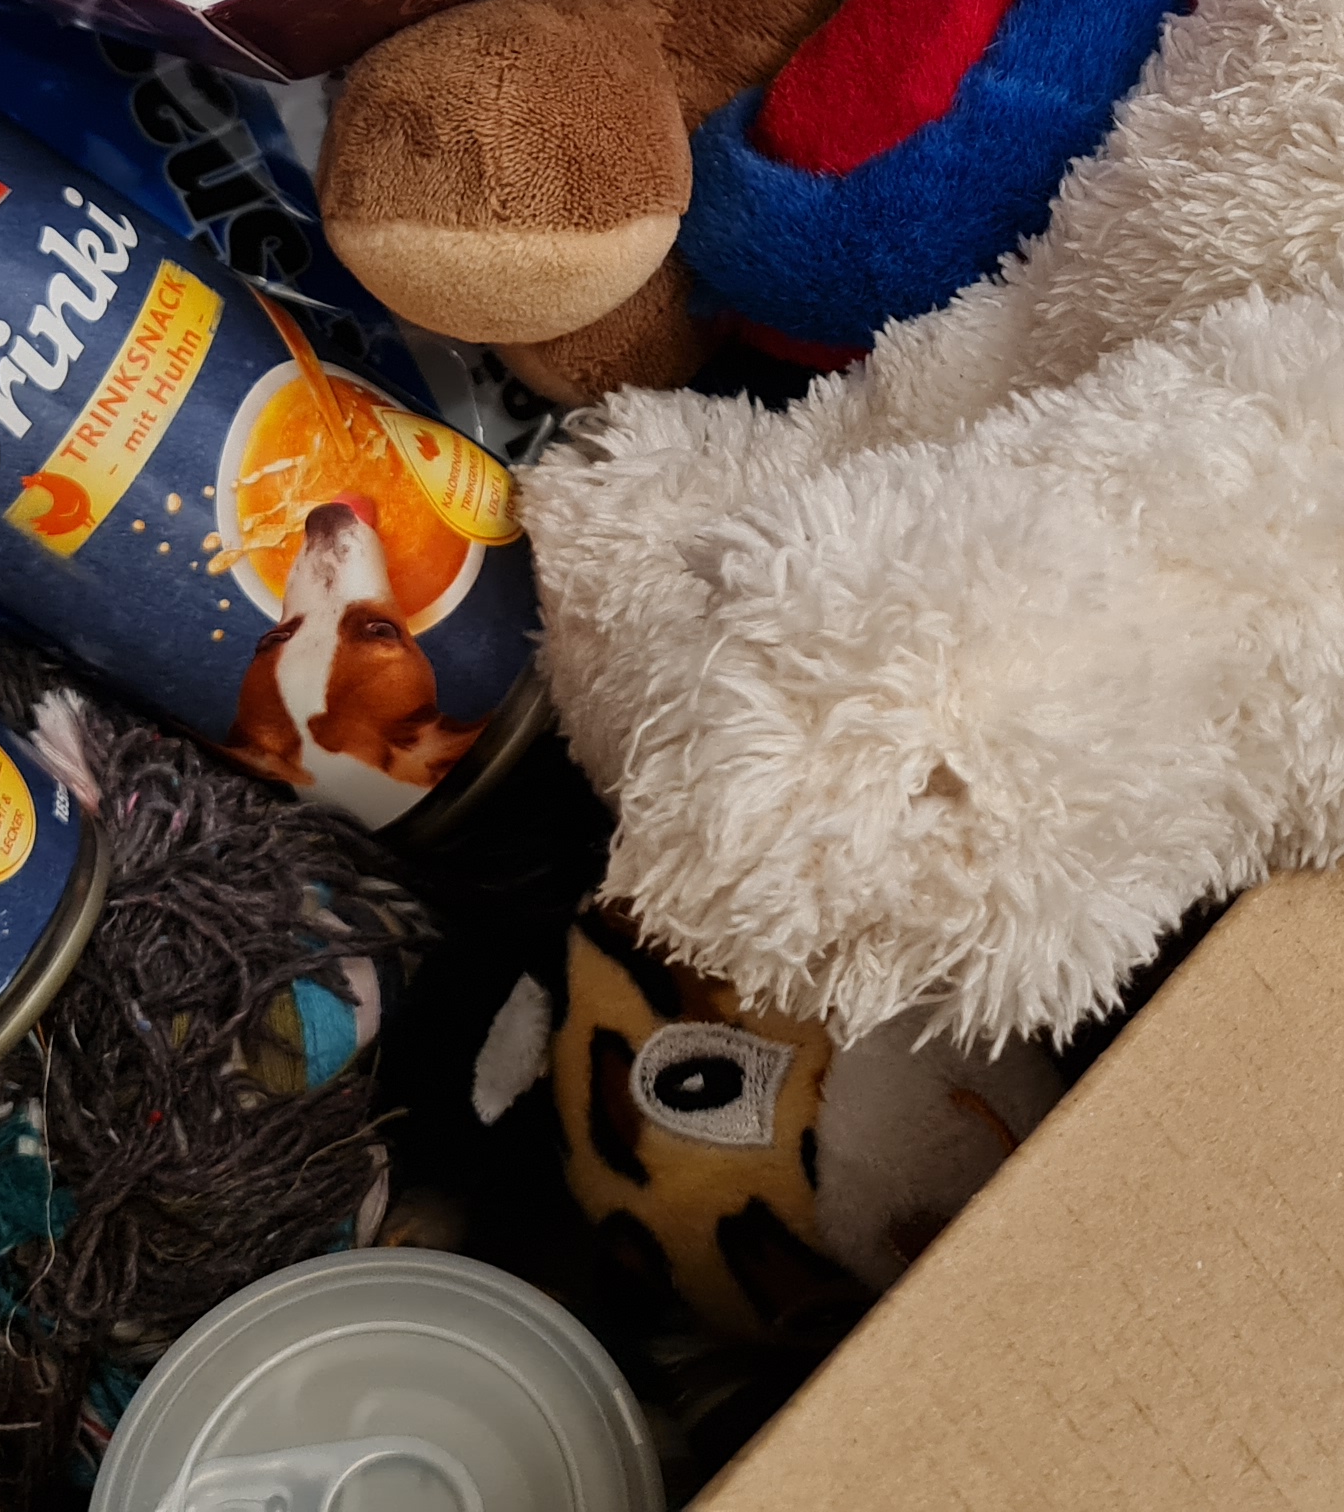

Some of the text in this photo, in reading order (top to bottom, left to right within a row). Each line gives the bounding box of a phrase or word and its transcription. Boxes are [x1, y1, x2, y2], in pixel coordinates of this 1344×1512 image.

[58, 269, 189, 466] TRINKSNACK
[122, 327, 204, 455] mit Huhn
[0, 807, 25, 857] LECKER
